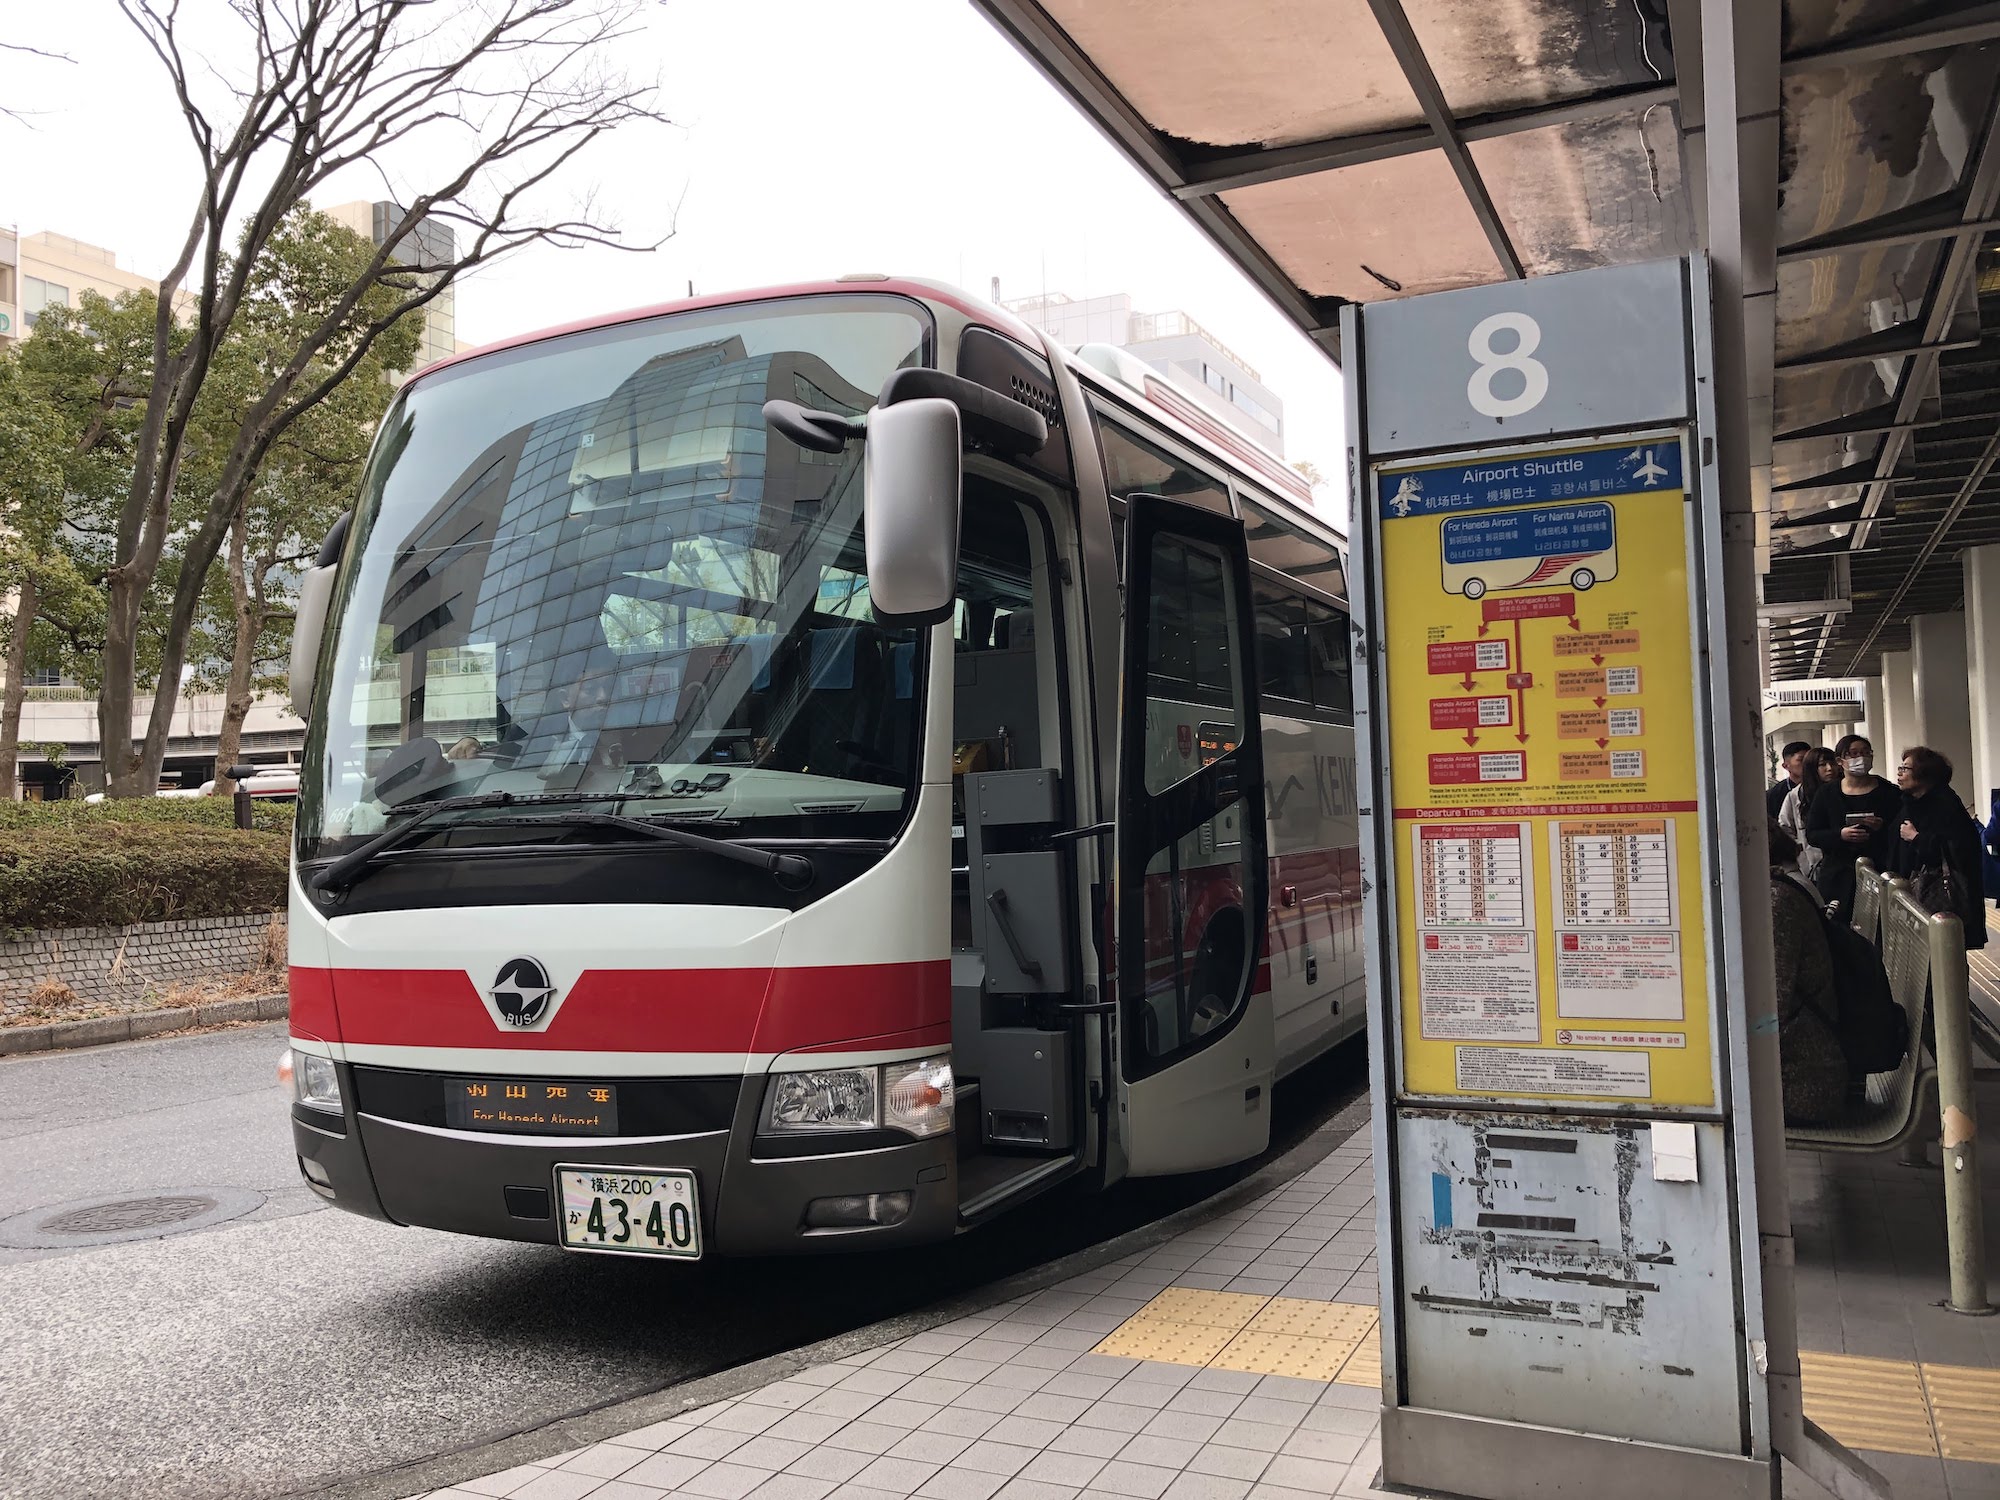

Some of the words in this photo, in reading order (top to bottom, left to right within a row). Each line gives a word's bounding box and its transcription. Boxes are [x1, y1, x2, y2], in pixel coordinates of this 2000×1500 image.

[1467, 312, 1549, 418] 8
[1462, 465, 1519, 484] Airport
[1524, 459, 1583, 477] Shuttle
[1425, 494, 1474, 509] 机场巴士
[1533, 514, 1546, 523] For
[1549, 512, 1575, 521] Narita
[1577, 508, 1607, 518] Airport
[1447, 523, 1460, 531] For
[1462, 520, 1490, 530] Haneda
[1491, 517, 1518, 527] Airport
[1416, 808, 1461, 817] Departure
[1462, 807, 1485, 816] Time
[506, 1012, 532, 1026] BUS
[570, 1210, 582, 1225] か
[587, 1197, 691, 1248] 43-40
